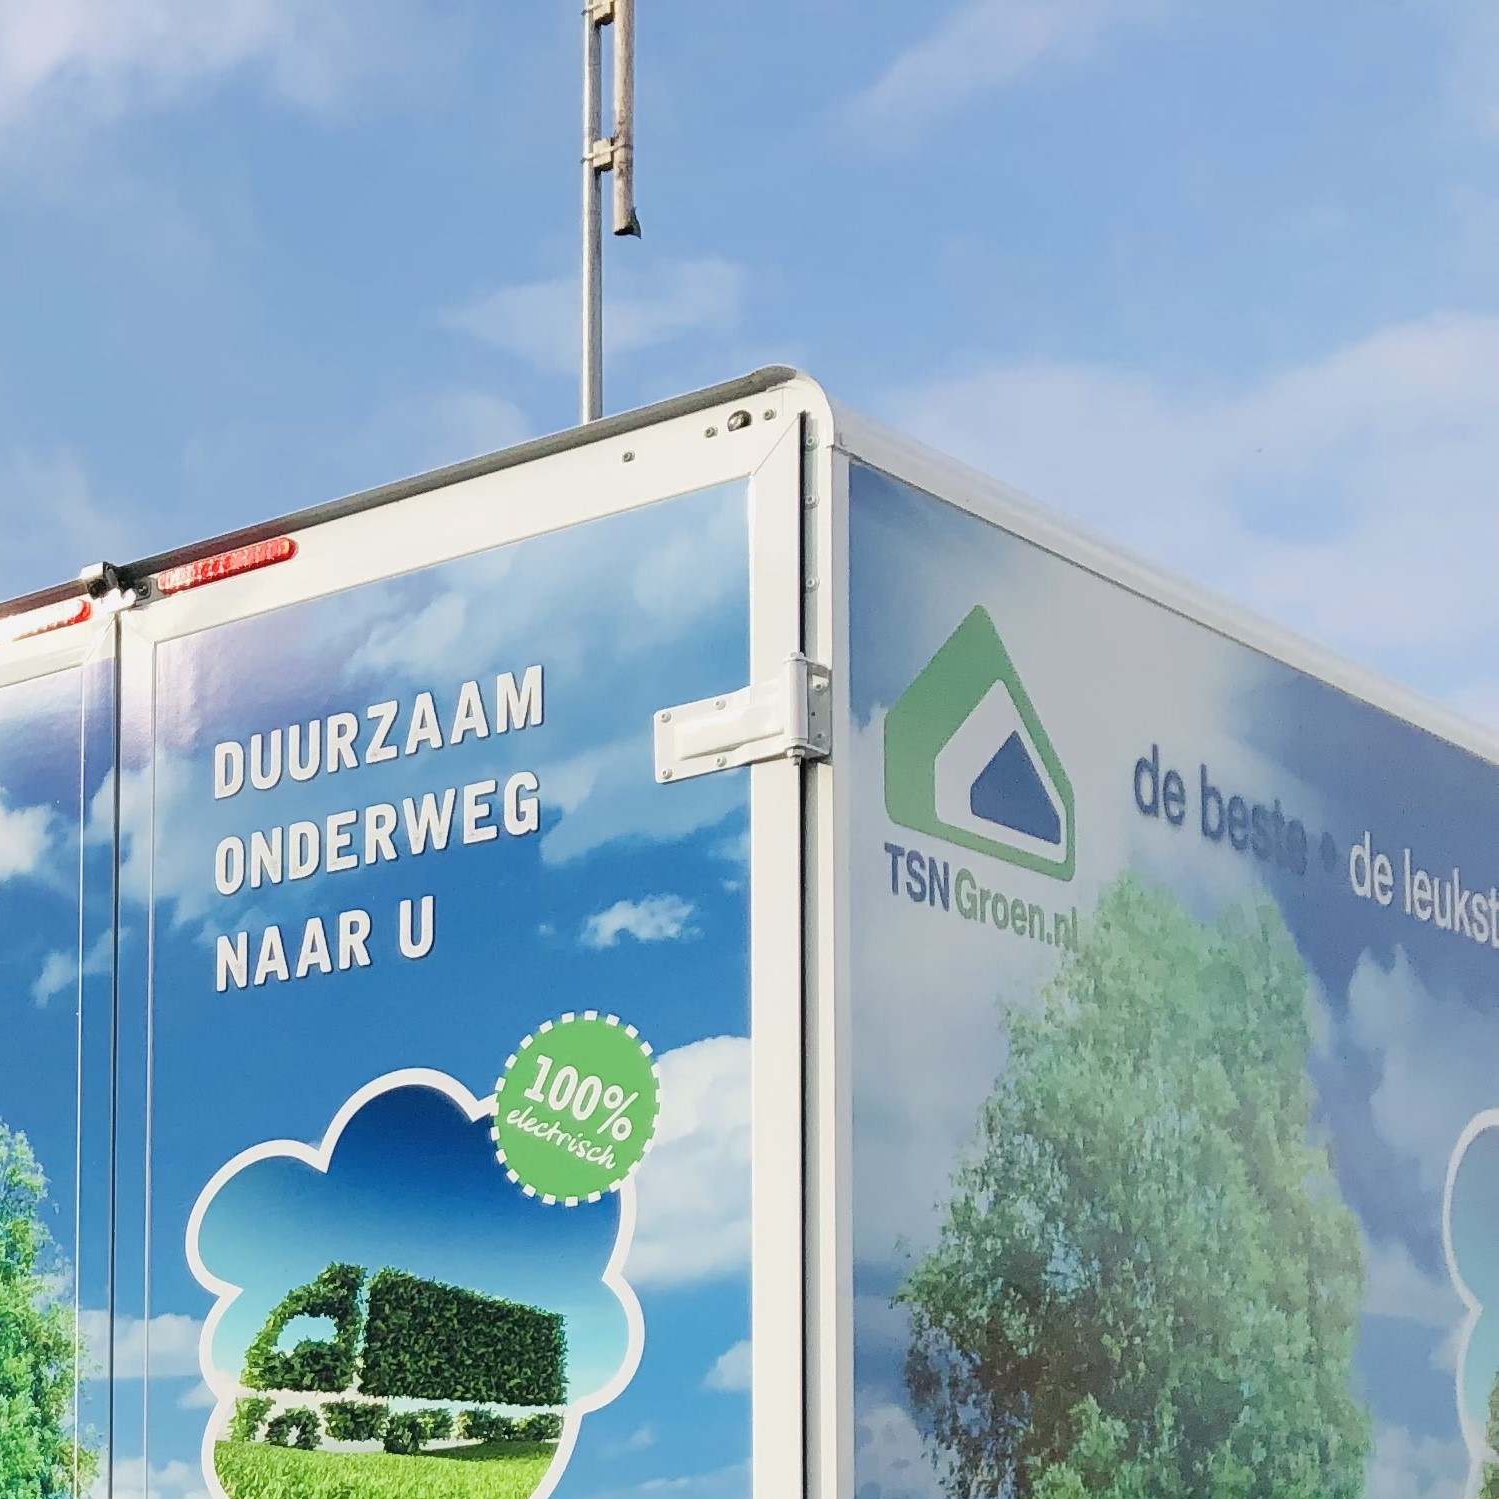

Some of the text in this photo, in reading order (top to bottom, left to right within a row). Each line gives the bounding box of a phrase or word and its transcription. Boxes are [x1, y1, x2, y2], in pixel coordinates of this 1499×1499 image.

[214, 665, 544, 800] DUURZAAM
[214, 772, 541, 896] ONDERWEG
[1134, 743, 1186, 826] de
[1350, 830, 1394, 907] de
[215, 896, 436, 993] NAAR U
[506, 1105, 617, 1170] electrisch
[523, 1054, 639, 1141] 100%
